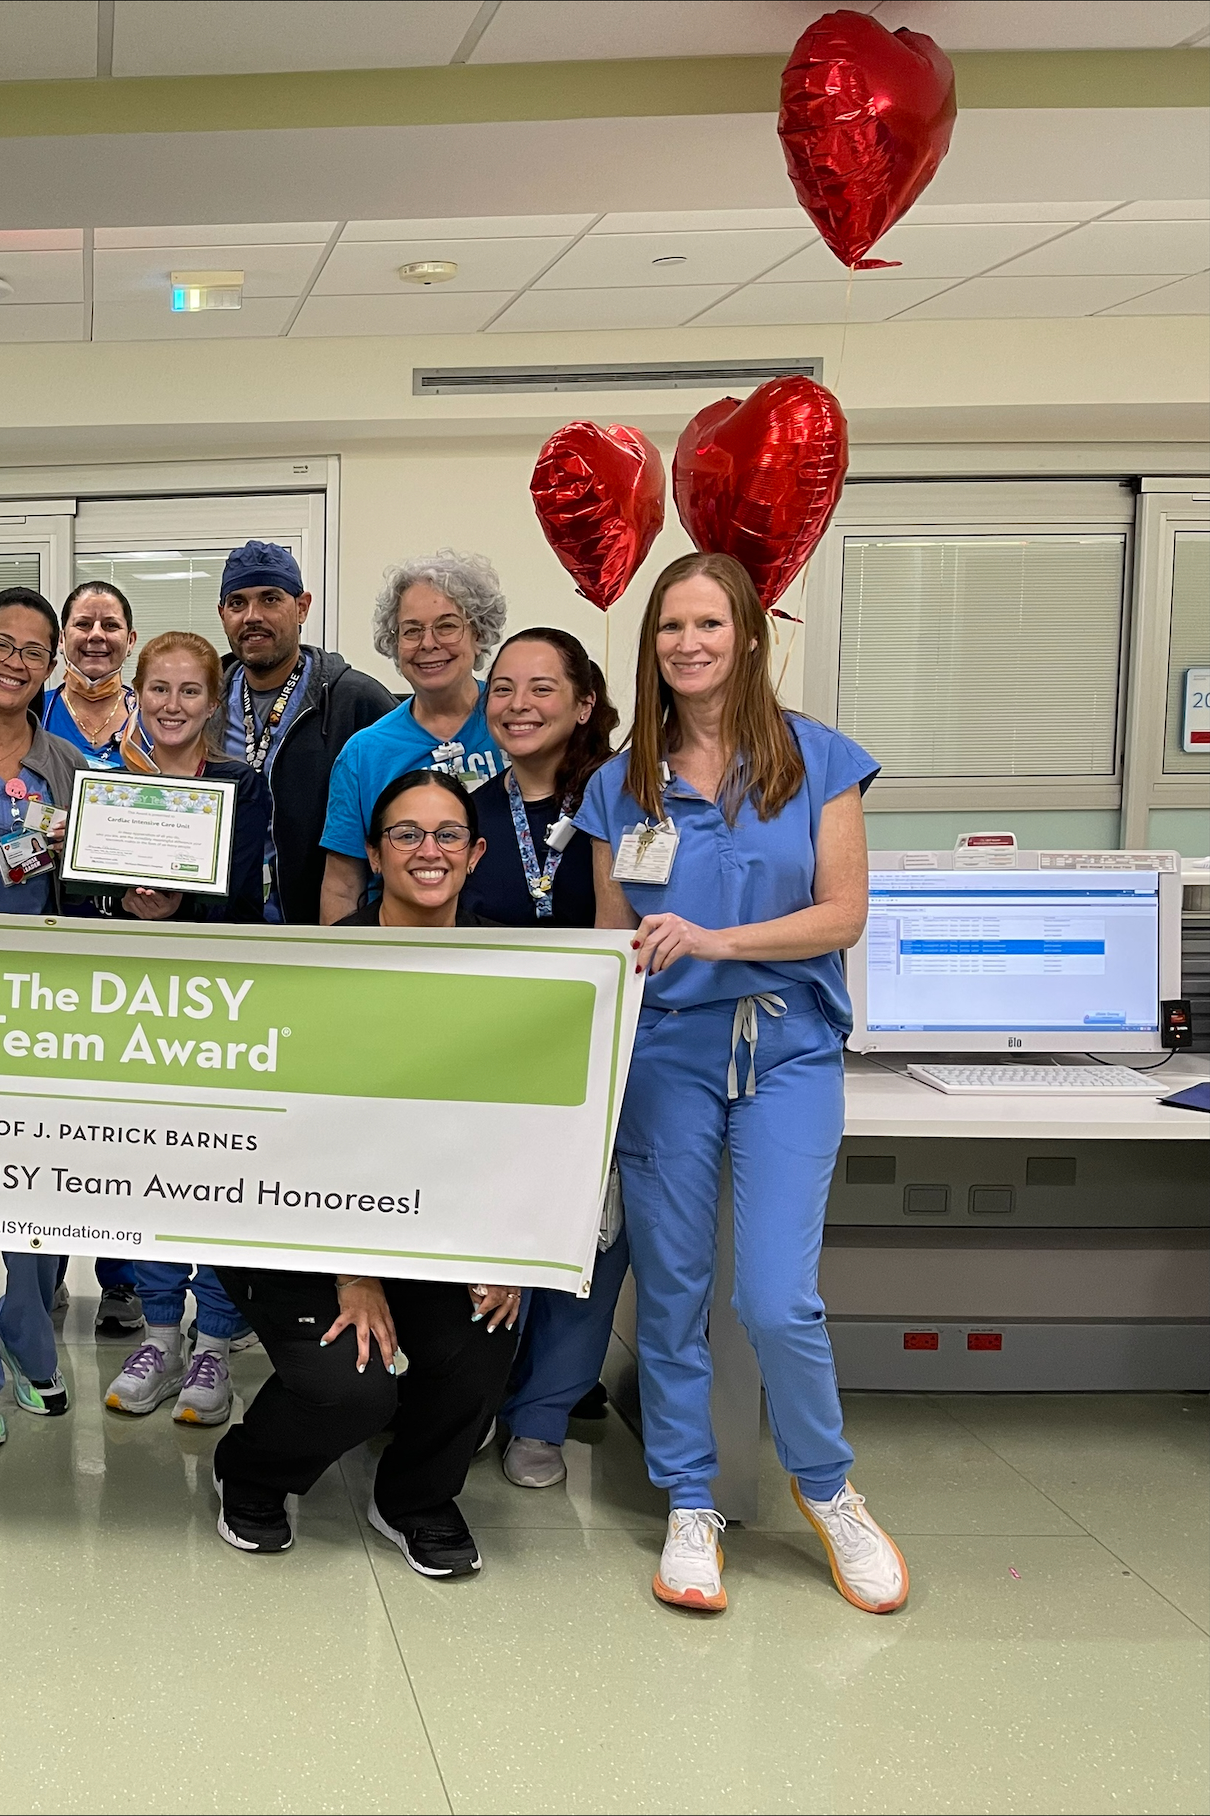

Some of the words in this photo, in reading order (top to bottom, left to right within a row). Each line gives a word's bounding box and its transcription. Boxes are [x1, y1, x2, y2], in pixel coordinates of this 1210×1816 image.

[107, 816, 130, 824] Cardiac
[132, 818, 160, 827] Intensive
[3, 972, 79, 1011] The
[91, 971, 255, 1021] DAISY
[33, 1122, 51, 1139] J.
[59, 1124, 157, 1145] PATRICK
[166, 1129, 258, 1151] BARNES
[51, 1167, 132, 1196] Team
[143, 1174, 244, 1204] Award
[258, 1180, 421, 1215] Honorees!
